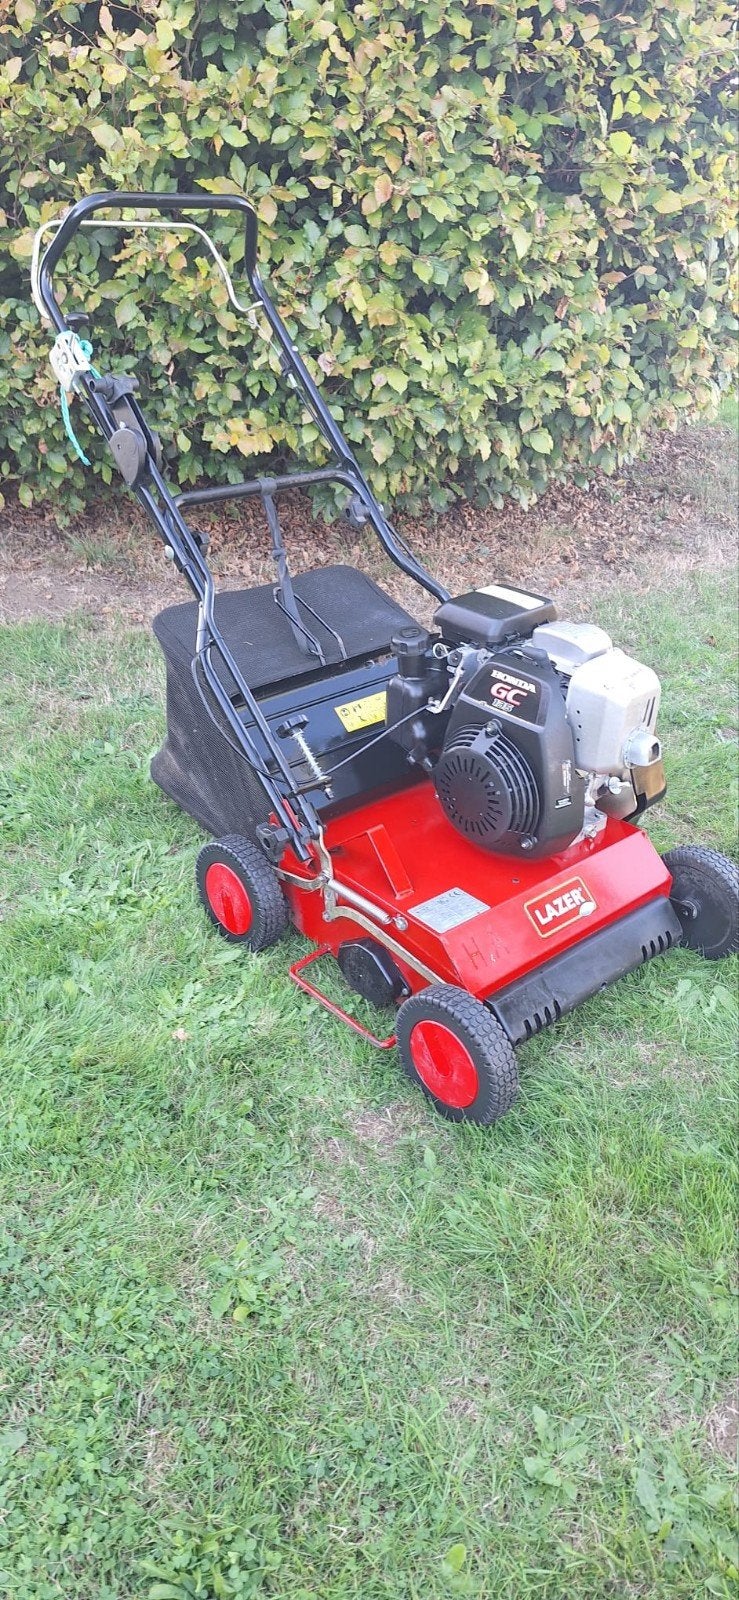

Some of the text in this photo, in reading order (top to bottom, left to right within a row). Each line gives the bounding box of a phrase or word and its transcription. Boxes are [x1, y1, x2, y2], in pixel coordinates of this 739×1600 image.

[490, 669, 536, 693] HONDA
[490, 682, 528, 706] GC
[534, 888, 586, 926] LAZER
